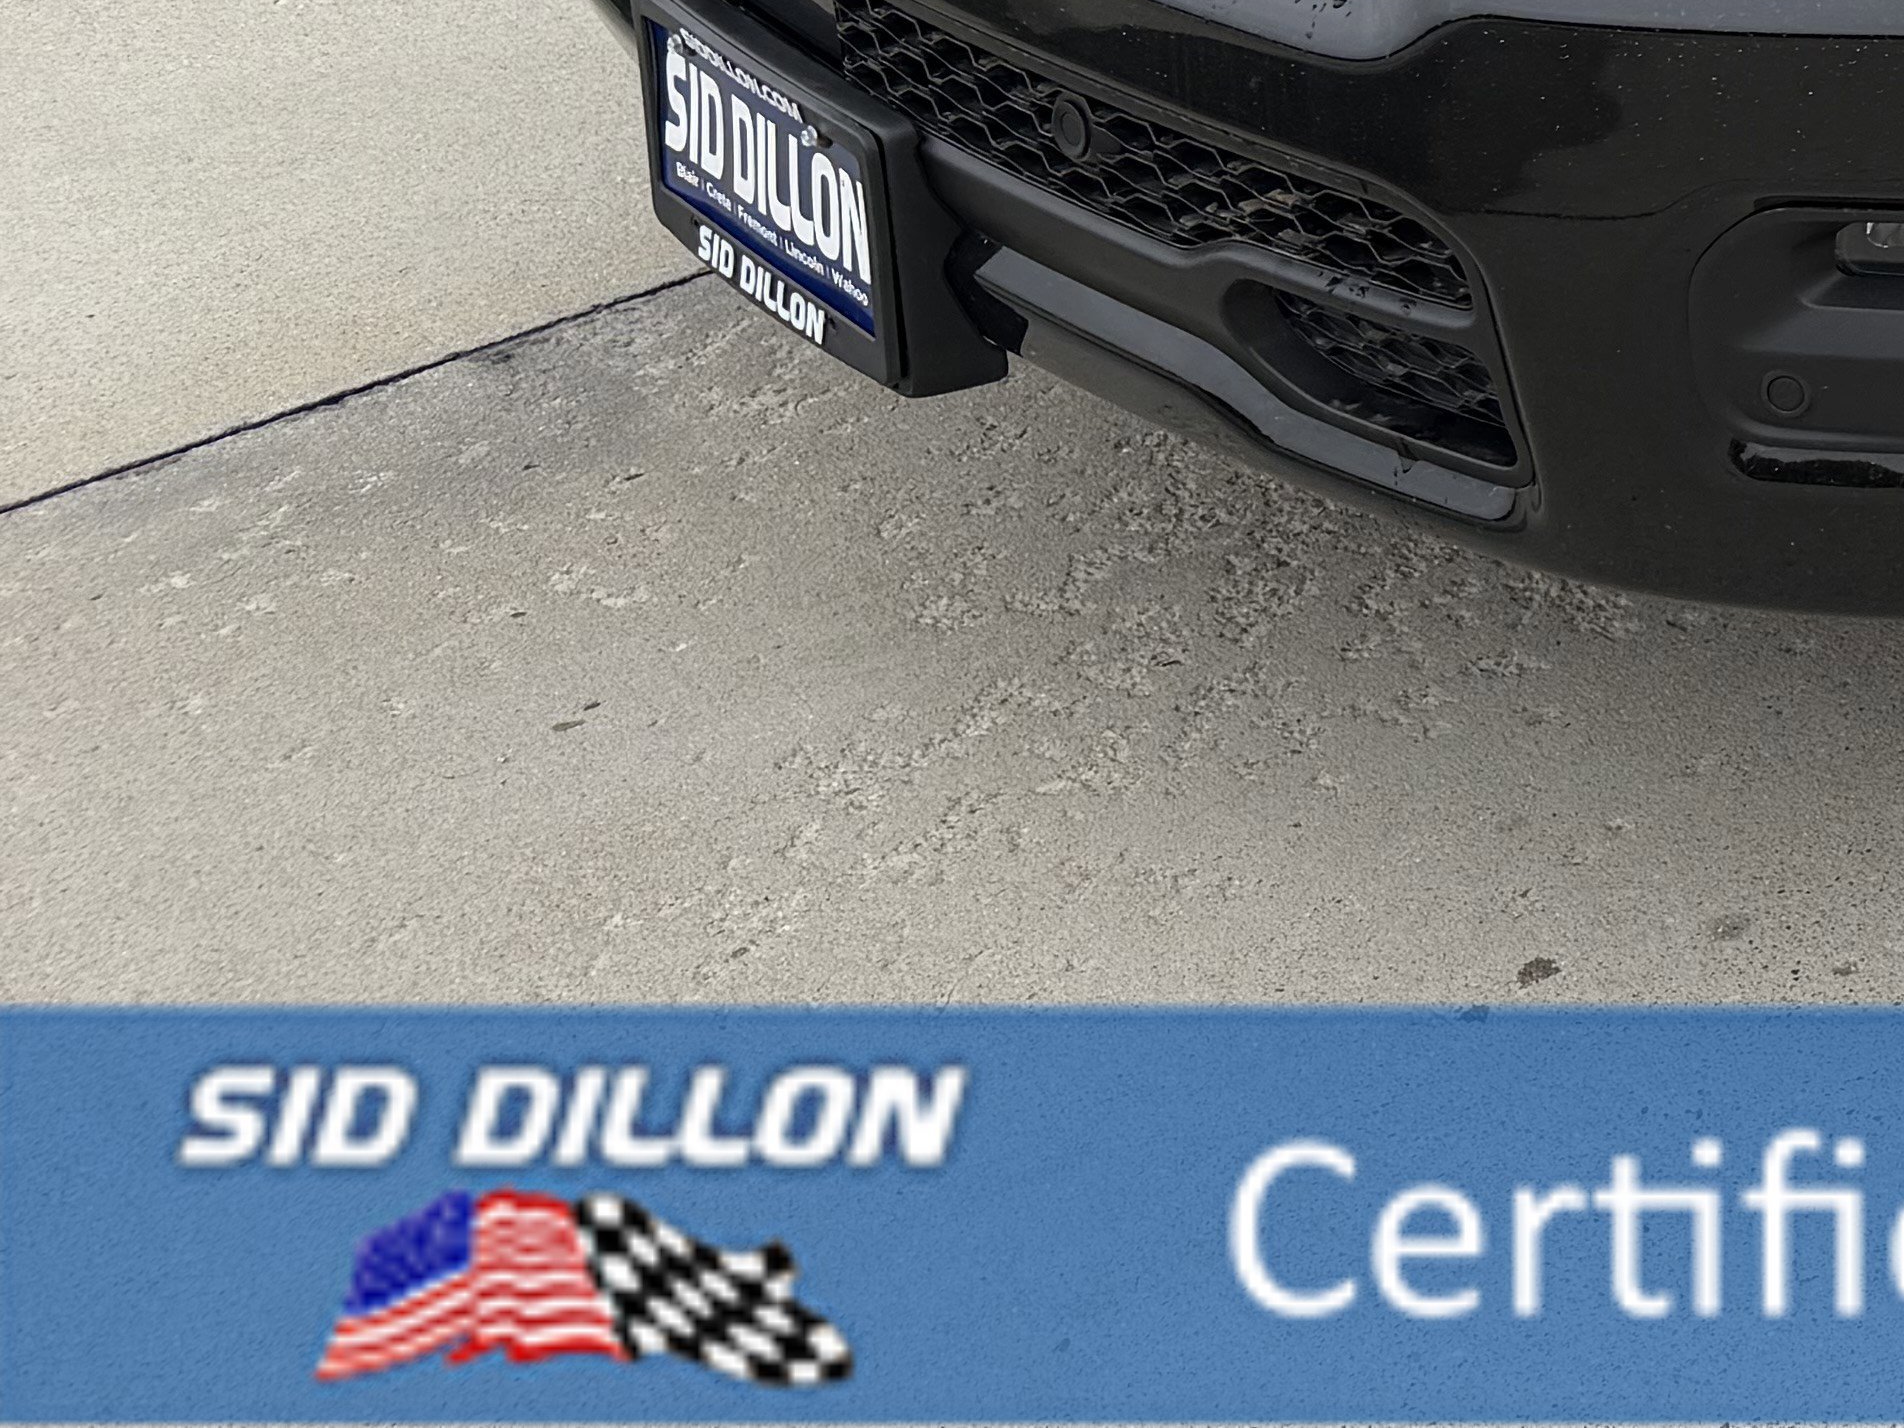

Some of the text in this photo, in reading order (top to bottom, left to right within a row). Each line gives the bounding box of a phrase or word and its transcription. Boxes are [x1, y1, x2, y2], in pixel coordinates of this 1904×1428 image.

[664, 46, 872, 285] SID DILLON
[698, 224, 827, 345] SID DILLON
[785, 238, 825, 276] Lincoln
